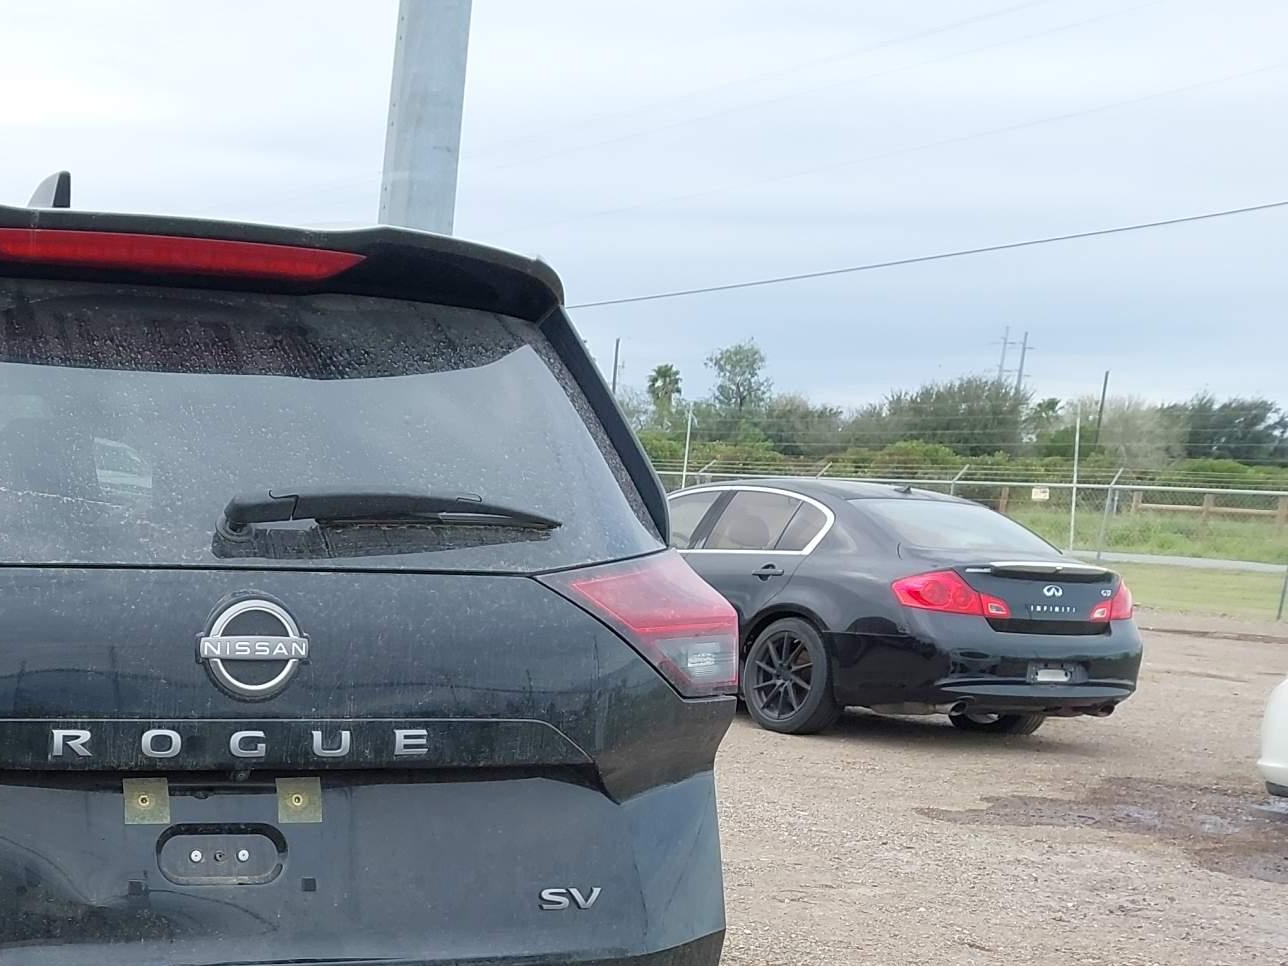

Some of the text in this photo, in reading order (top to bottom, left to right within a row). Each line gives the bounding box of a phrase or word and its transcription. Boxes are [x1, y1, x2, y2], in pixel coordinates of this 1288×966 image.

[1031, 604, 1076, 613] INFINITI
[203, 641, 307, 656] NISSAN
[50, 728, 429, 758] ROGUE
[539, 886, 602, 911] SV
